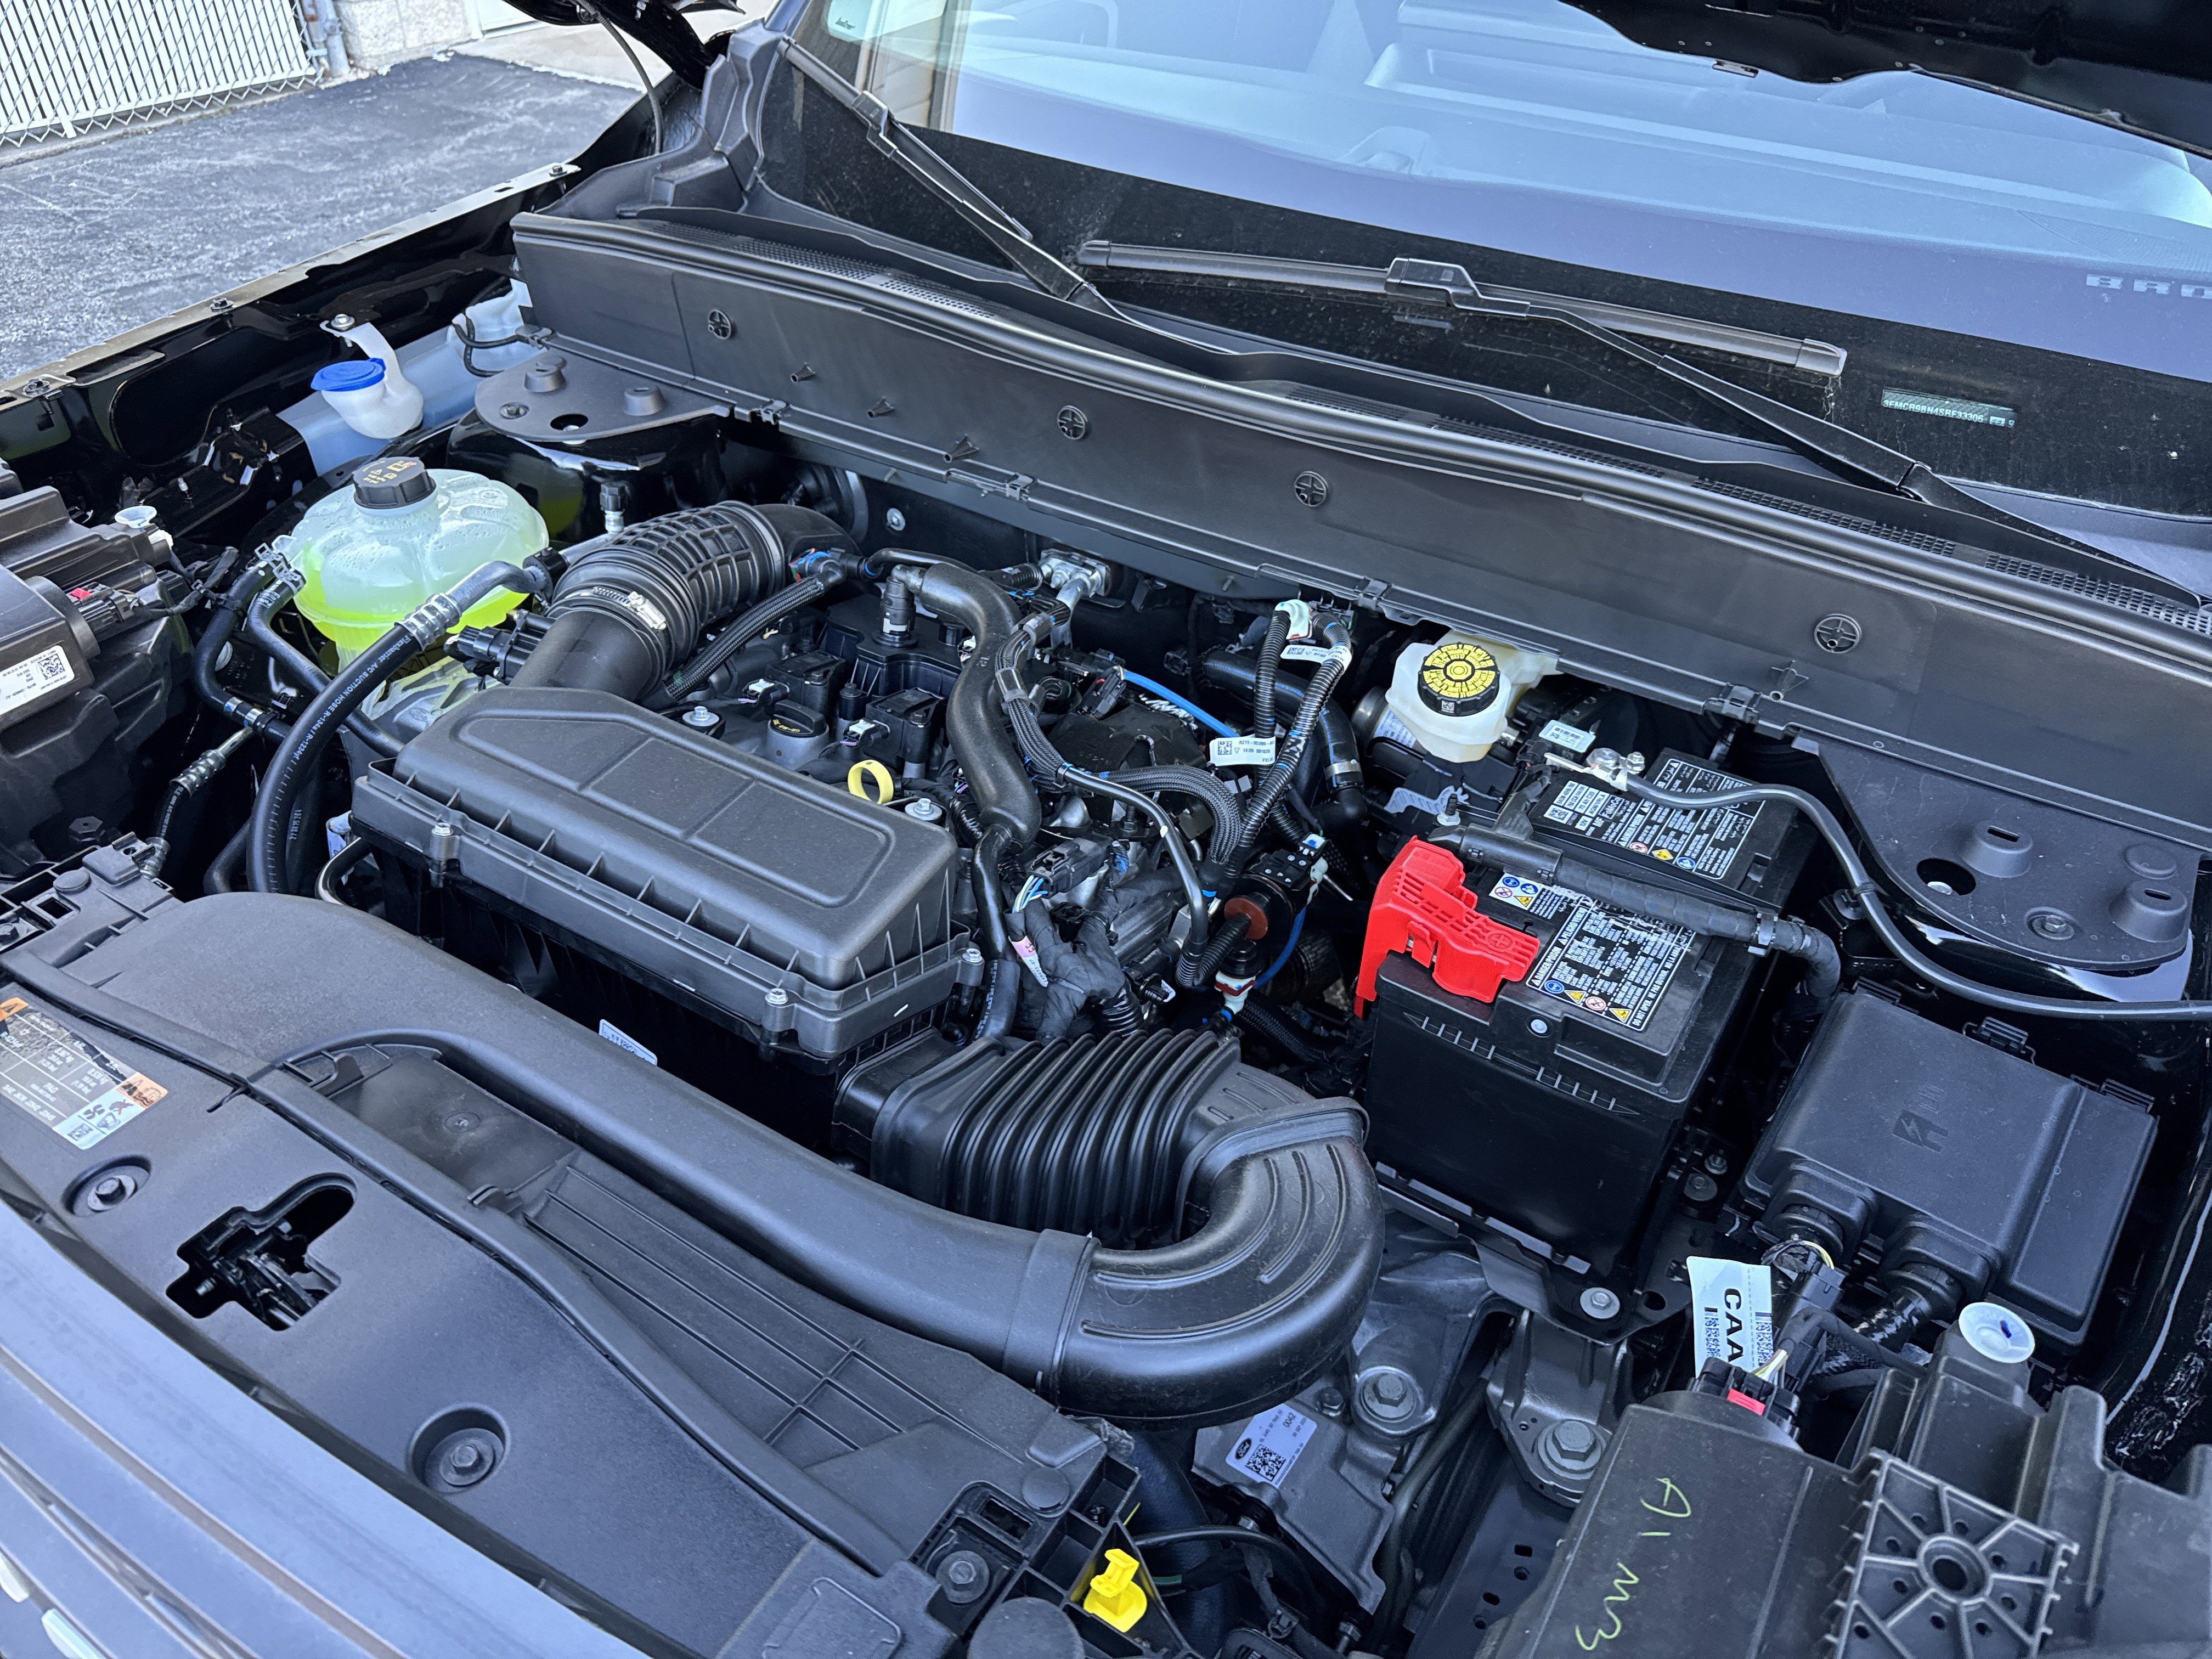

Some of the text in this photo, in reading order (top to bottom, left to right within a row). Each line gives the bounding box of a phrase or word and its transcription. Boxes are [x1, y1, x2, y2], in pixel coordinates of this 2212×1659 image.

[377, 634, 411, 663] Flexbarrier
[365, 661, 378, 673] A/C
[342, 670, 369, 696] SUCTION
[328, 693, 345, 712] HOSE
[1585, 791, 1595, 799] C20
[1601, 796, 1621, 817] FoMoCo
[1579, 819, 1588, 827] 12V
[1533, 945, 1562, 980] DANGER/POISON
[1650, 983, 1661, 993] PAS
[1646, 991, 1656, 999] NE
[1639, 997, 1653, 1012] OPEN.
[1634, 1009, 1646, 1020] NOT
[1631, 1018, 1641, 1026] DO
[42, 1082, 60, 1093] PAG
[1724, 1288, 1743, 1362] CAA
[1282, 1411, 1296, 1428] 0042
